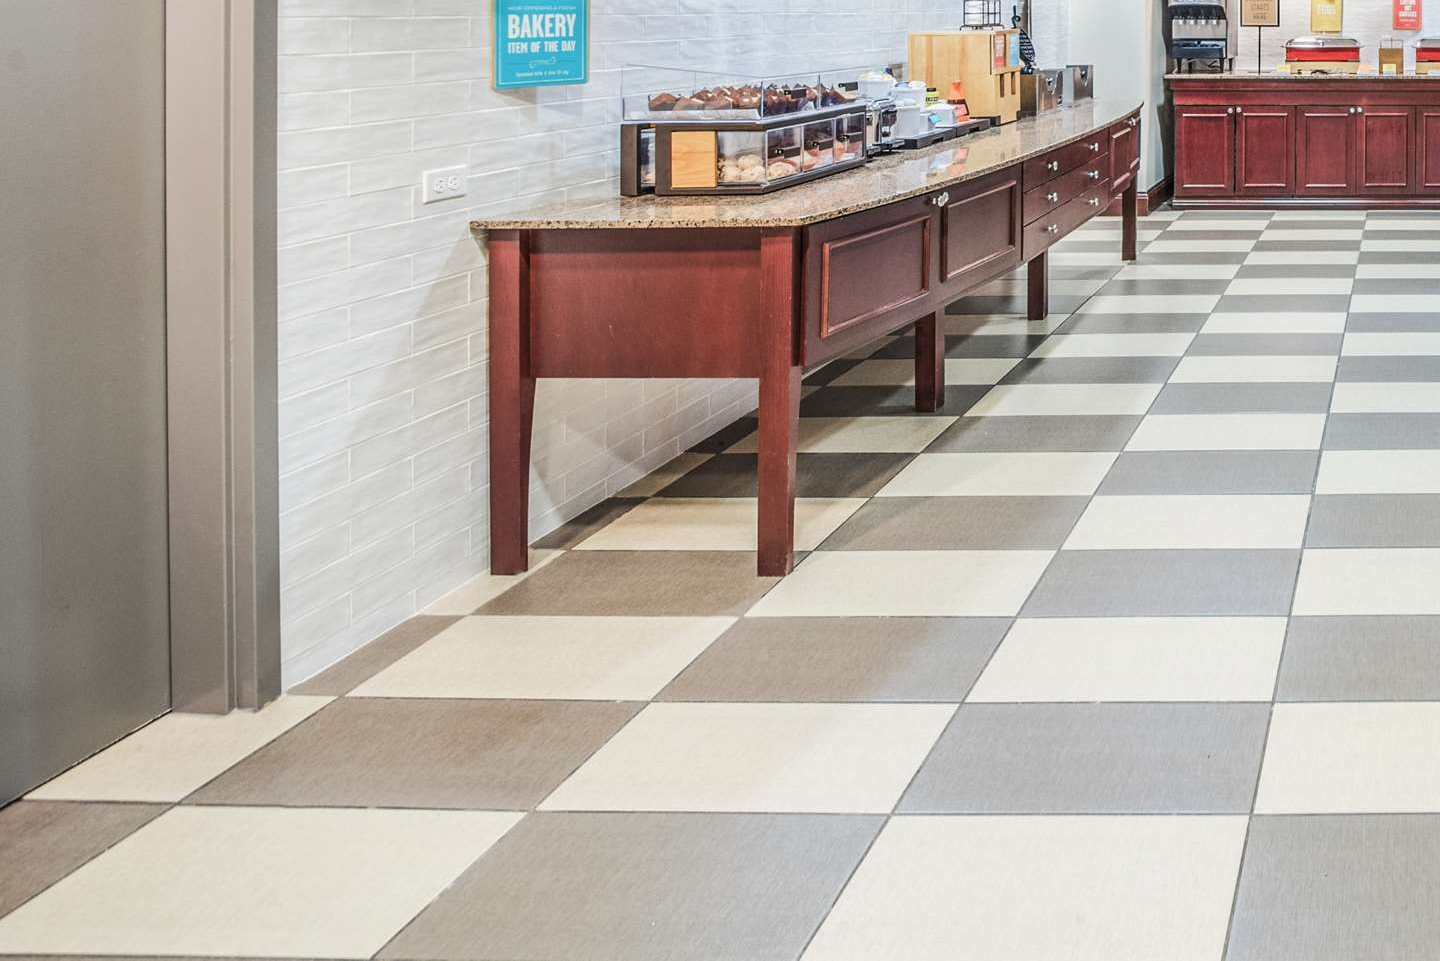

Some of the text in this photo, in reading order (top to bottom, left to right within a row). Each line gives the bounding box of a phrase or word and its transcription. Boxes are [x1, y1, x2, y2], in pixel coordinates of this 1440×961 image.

[507, 13, 577, 39] BAKERY
[507, 39, 577, 54] ITEM OF THE DAY
